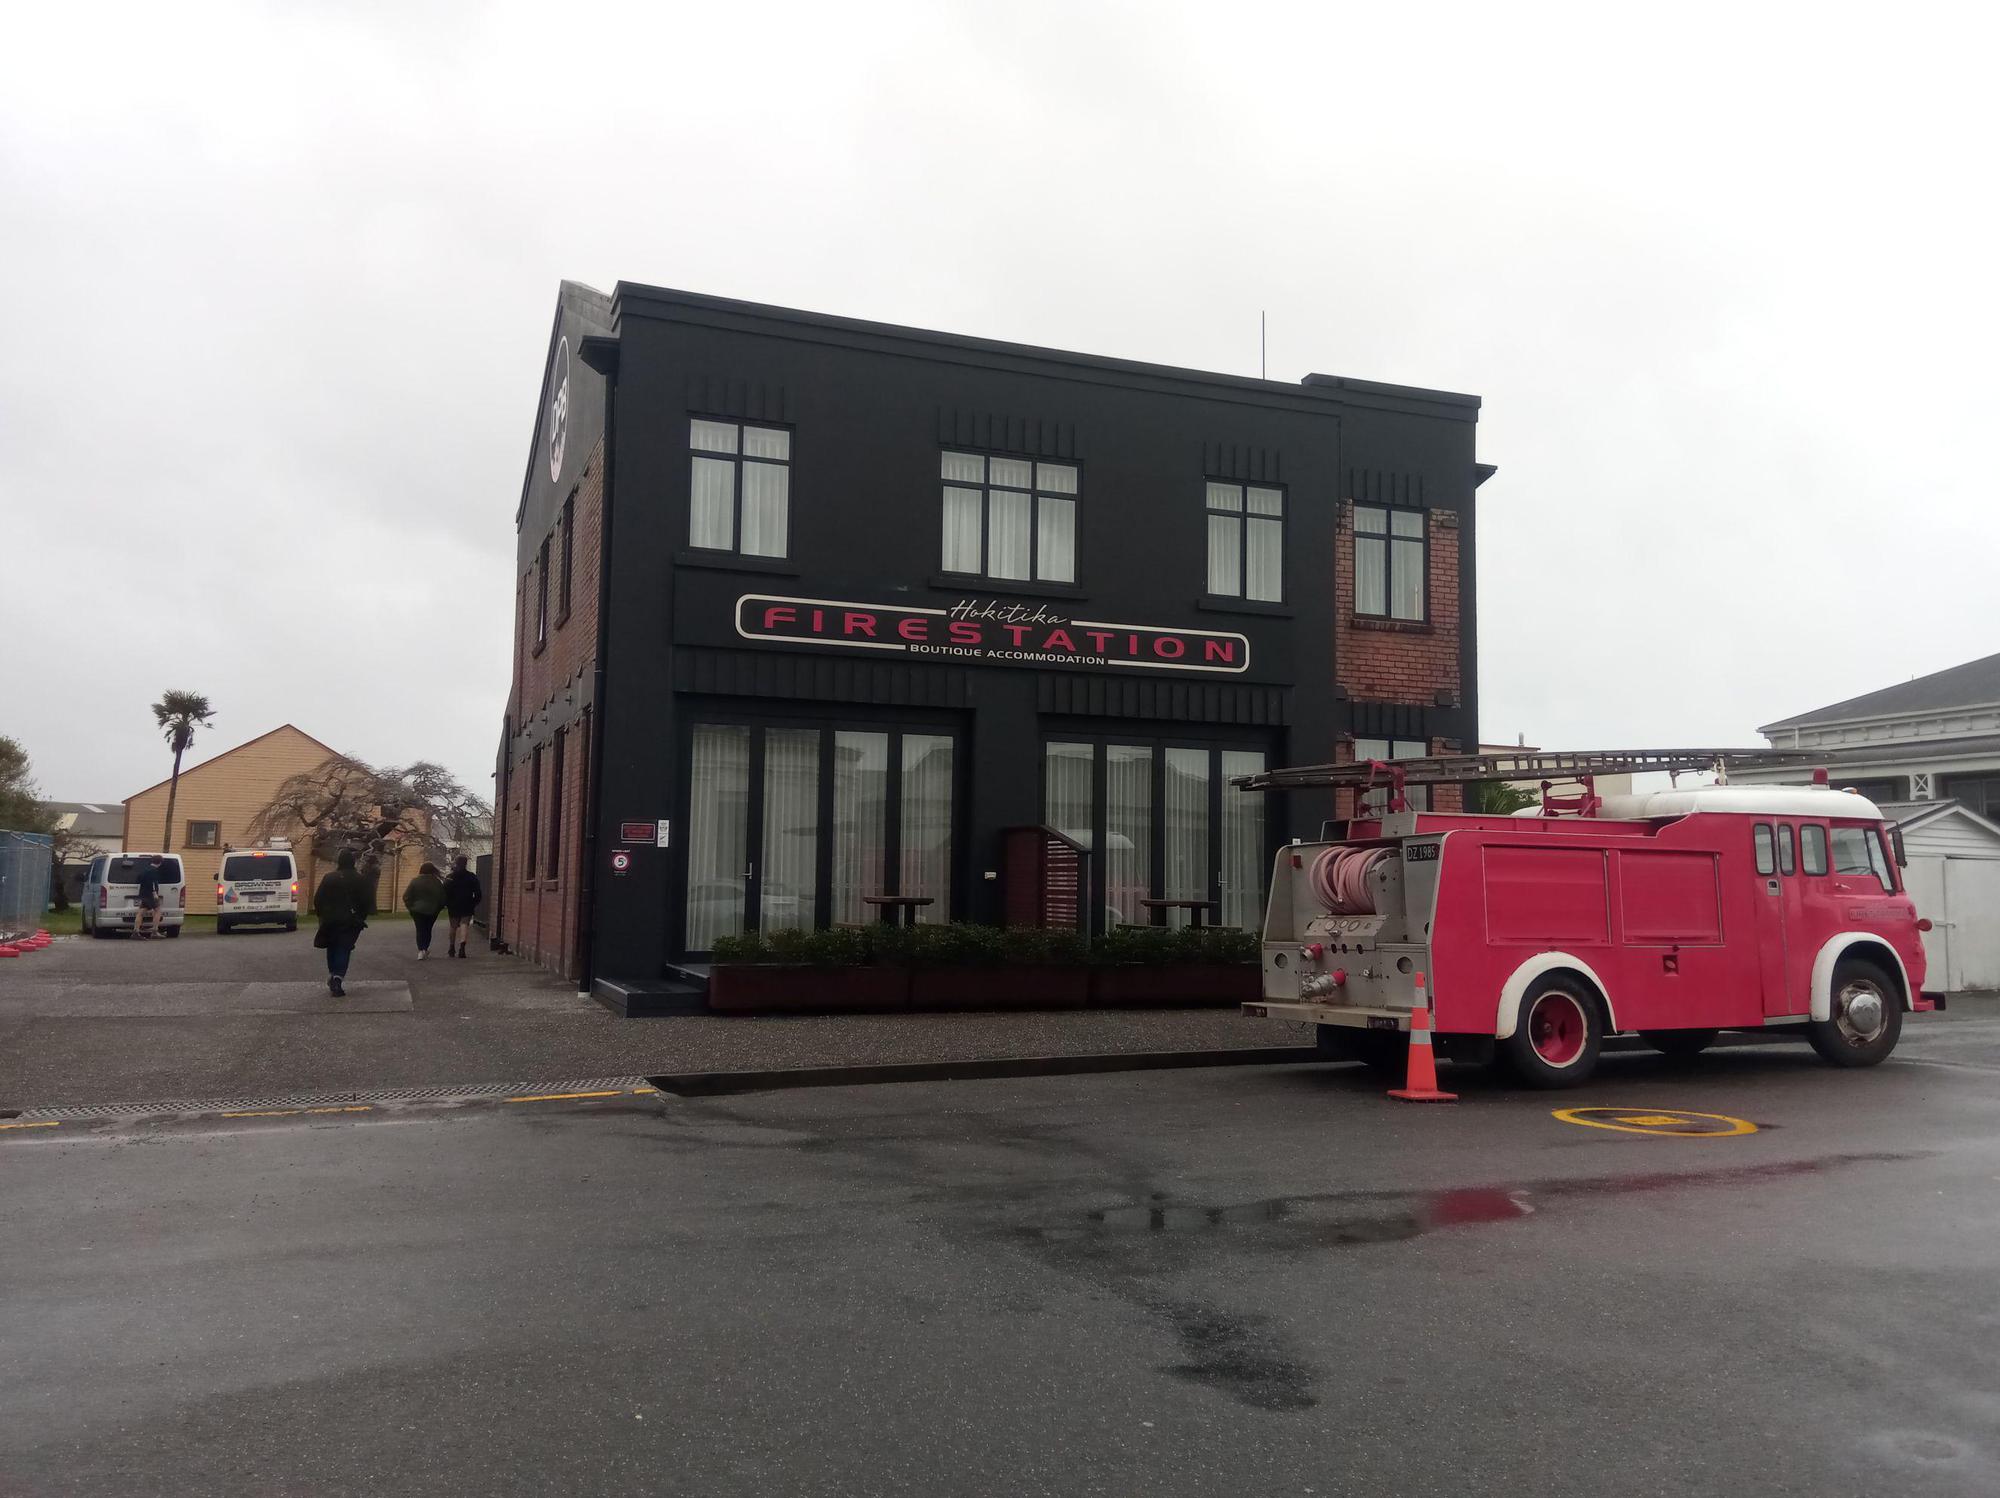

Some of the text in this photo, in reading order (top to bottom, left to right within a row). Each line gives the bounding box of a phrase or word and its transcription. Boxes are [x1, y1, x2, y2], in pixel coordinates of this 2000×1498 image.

[950, 599, 1068, 625] Hokitika
[763, 607, 1234, 662] FIRESTATION
[910, 644, 1105, 665] BOUTIQUE ACCOMMODATION
[617, 857, 625, 867] 5
[1407, 845, 1436, 860] DZ 1985
